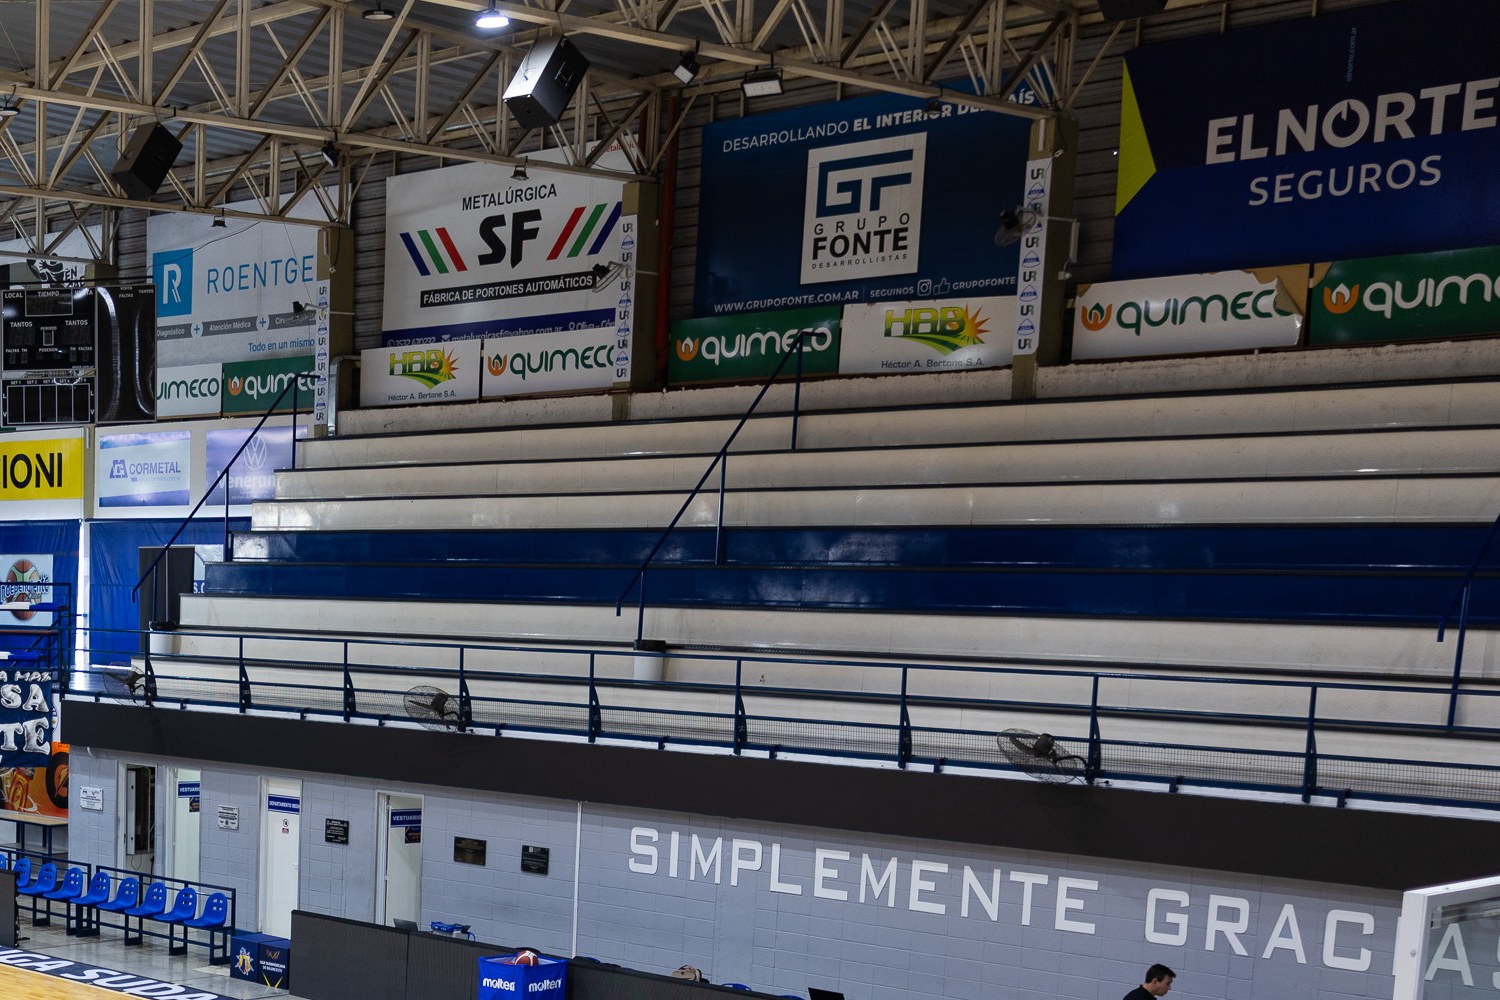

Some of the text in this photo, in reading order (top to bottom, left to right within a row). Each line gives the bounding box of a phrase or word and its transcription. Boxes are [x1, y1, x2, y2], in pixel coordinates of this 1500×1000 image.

[722, 121, 849, 153] DESARROLLANDO
[853, 118, 872, 132] EL
[1248, 155, 1442, 206] SEGUROS
[461, 183, 557, 211] METALÚRGICA
[813, 212, 910, 236] GRUPO
[477, 208, 543, 269] SF
[811, 227, 909, 261] FONTE
[1025, 236, 1040, 249] UR
[811, 253, 908, 270] DESARROLLISTAS
[206, 254, 315, 295] ROENTGE
[422, 275, 593, 305] FÁBRICA DE PORTONES AUTOMÁTICOS
[713, 276, 1017, 314] WWW.GRUPOFONTE.COM.AR SEGUINOS GRUPOFONTE
[209, 322, 232, 332] Atención
[278, 341, 289, 349] un
[289, 338, 315, 349] mismo
[1017, 338, 1032, 350] UR
[881, 357, 985, 370] Héctor A. Bertone S.A.
[388, 389, 457, 401] Héctor A. Bertone S.A.
[129, 460, 181, 475] CORMETAL
[216, 469, 277, 489] Veneran
[627, 826, 1500, 992] SIMPLEMENTE GRACA
[482, 977, 516, 992] molten
[528, 978, 562, 993] molten
